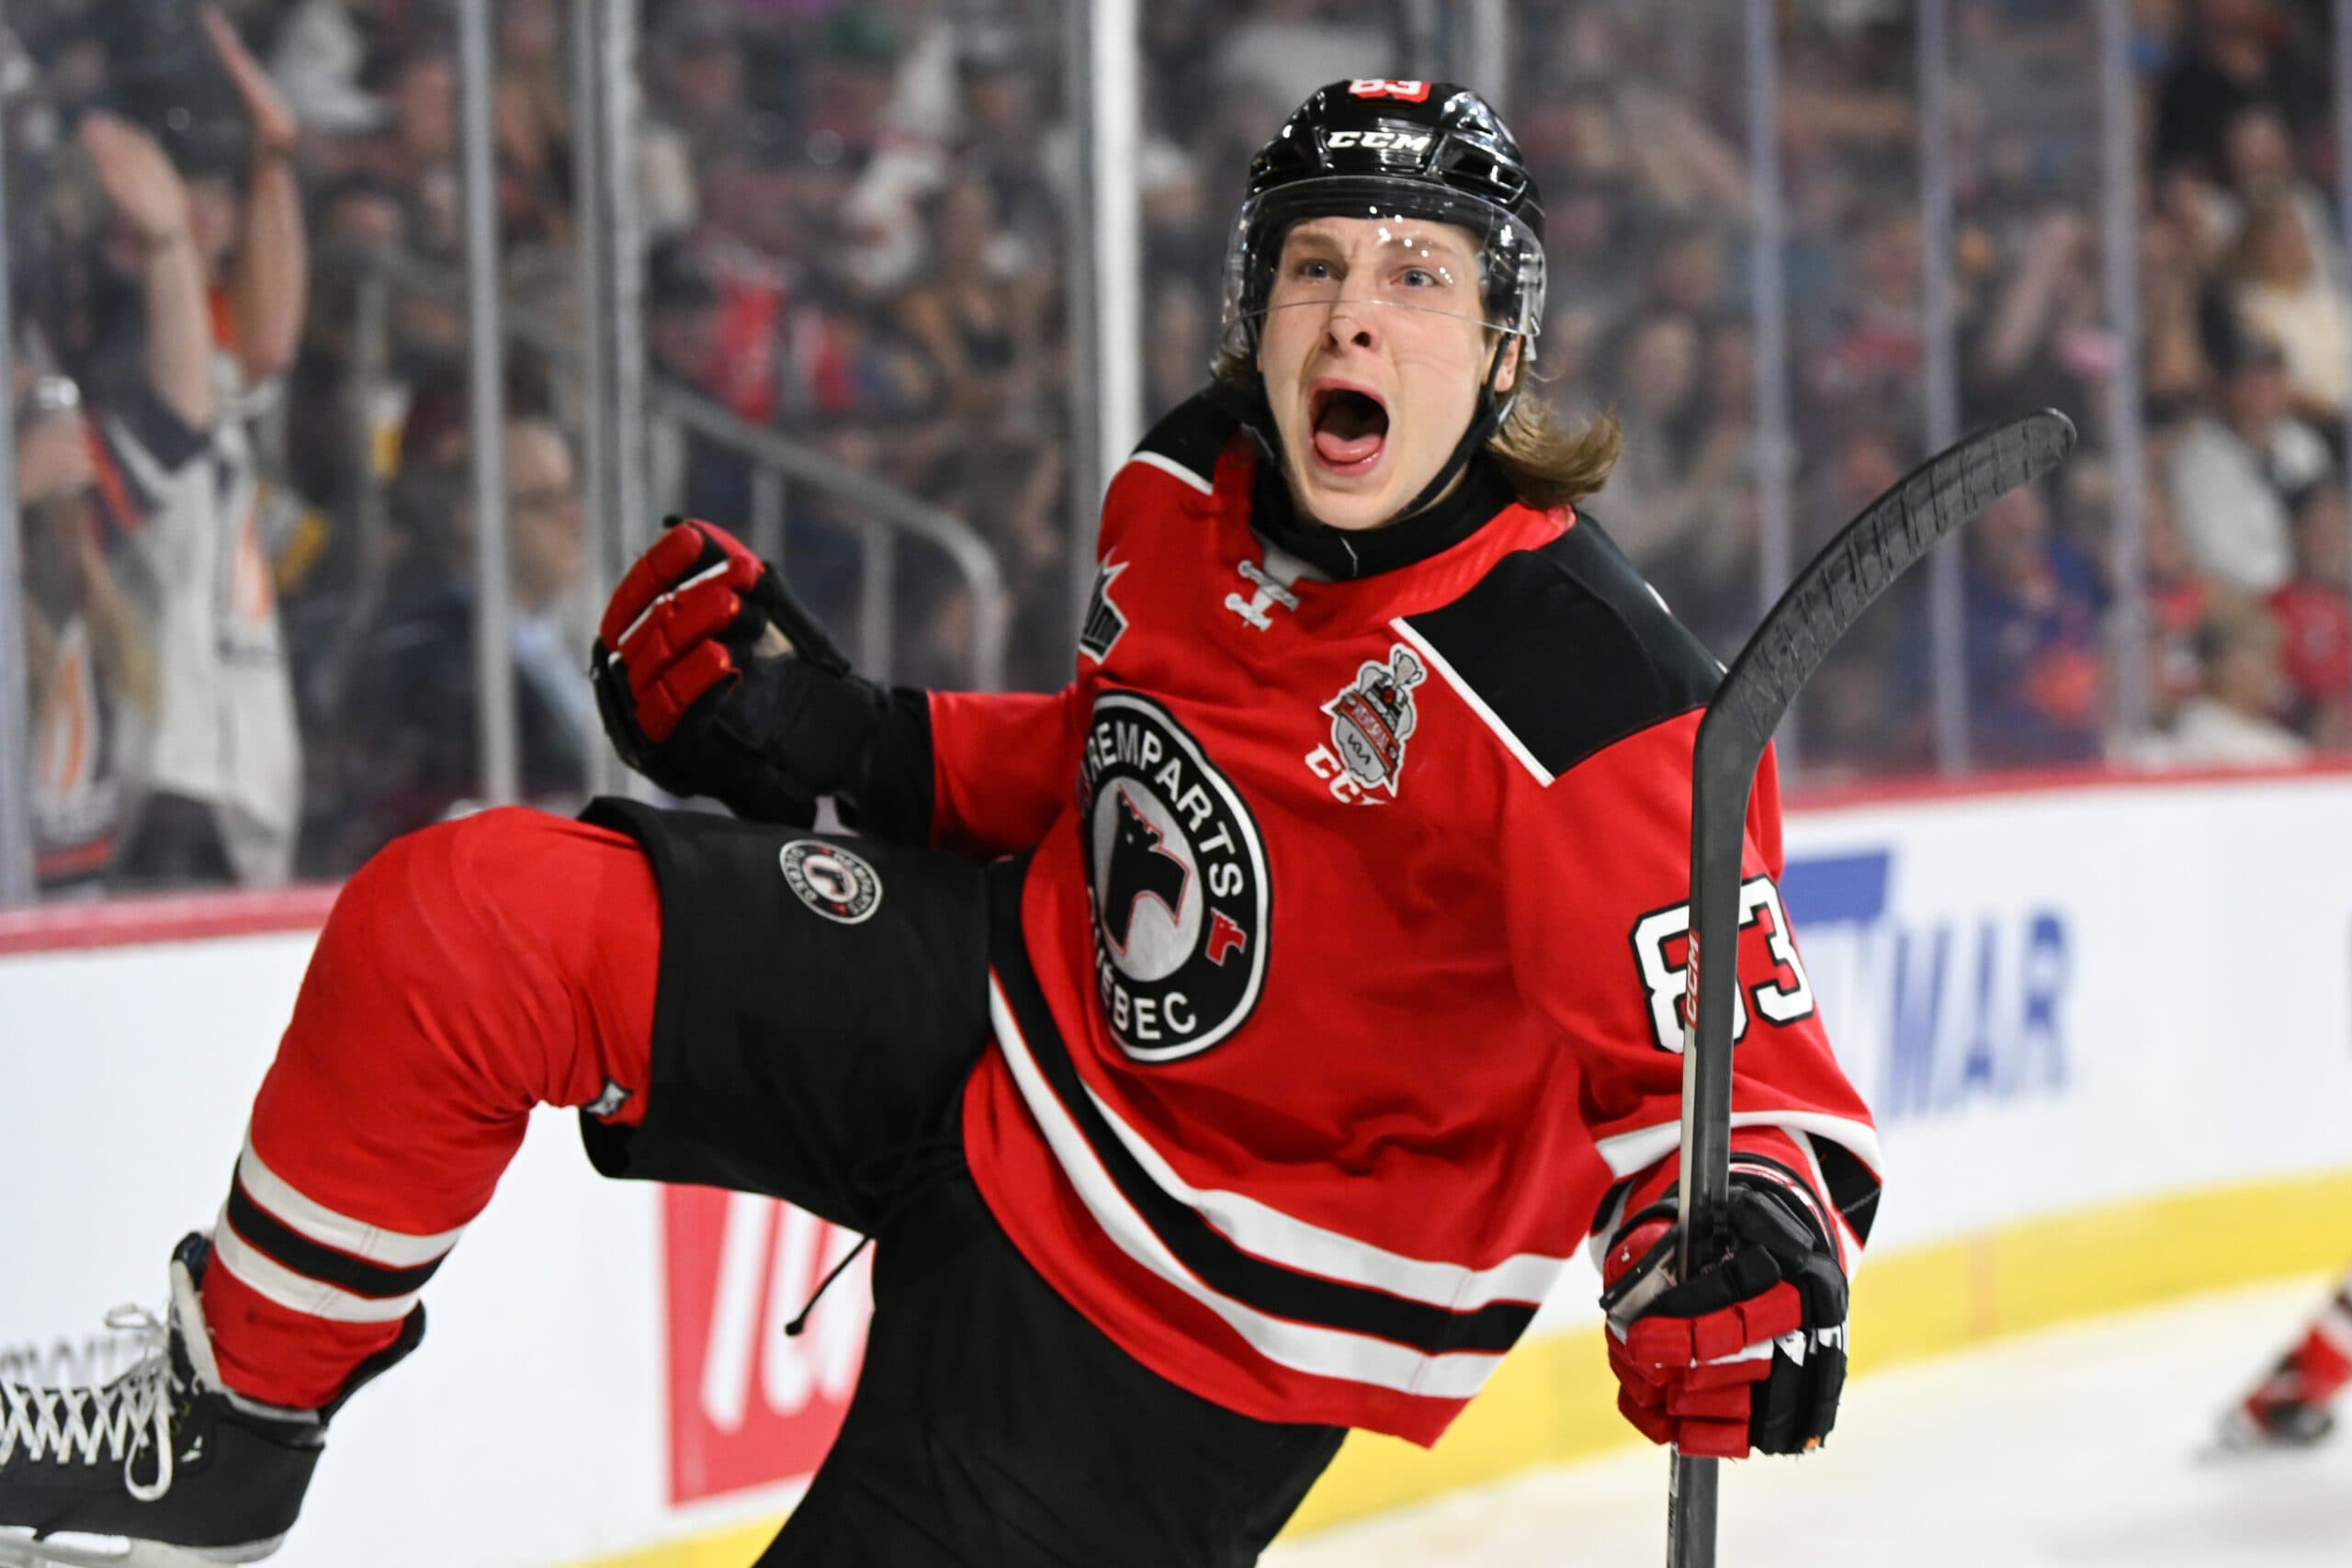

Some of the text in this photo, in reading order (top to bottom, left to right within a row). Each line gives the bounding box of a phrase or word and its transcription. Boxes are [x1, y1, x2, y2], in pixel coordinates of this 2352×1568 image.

[1326, 130, 1433, 152] CCM
[1086, 720, 1244, 898] REMPARTS
[1304, 741, 1388, 806] CC
[1685, 933, 1700, 1023] CCM
